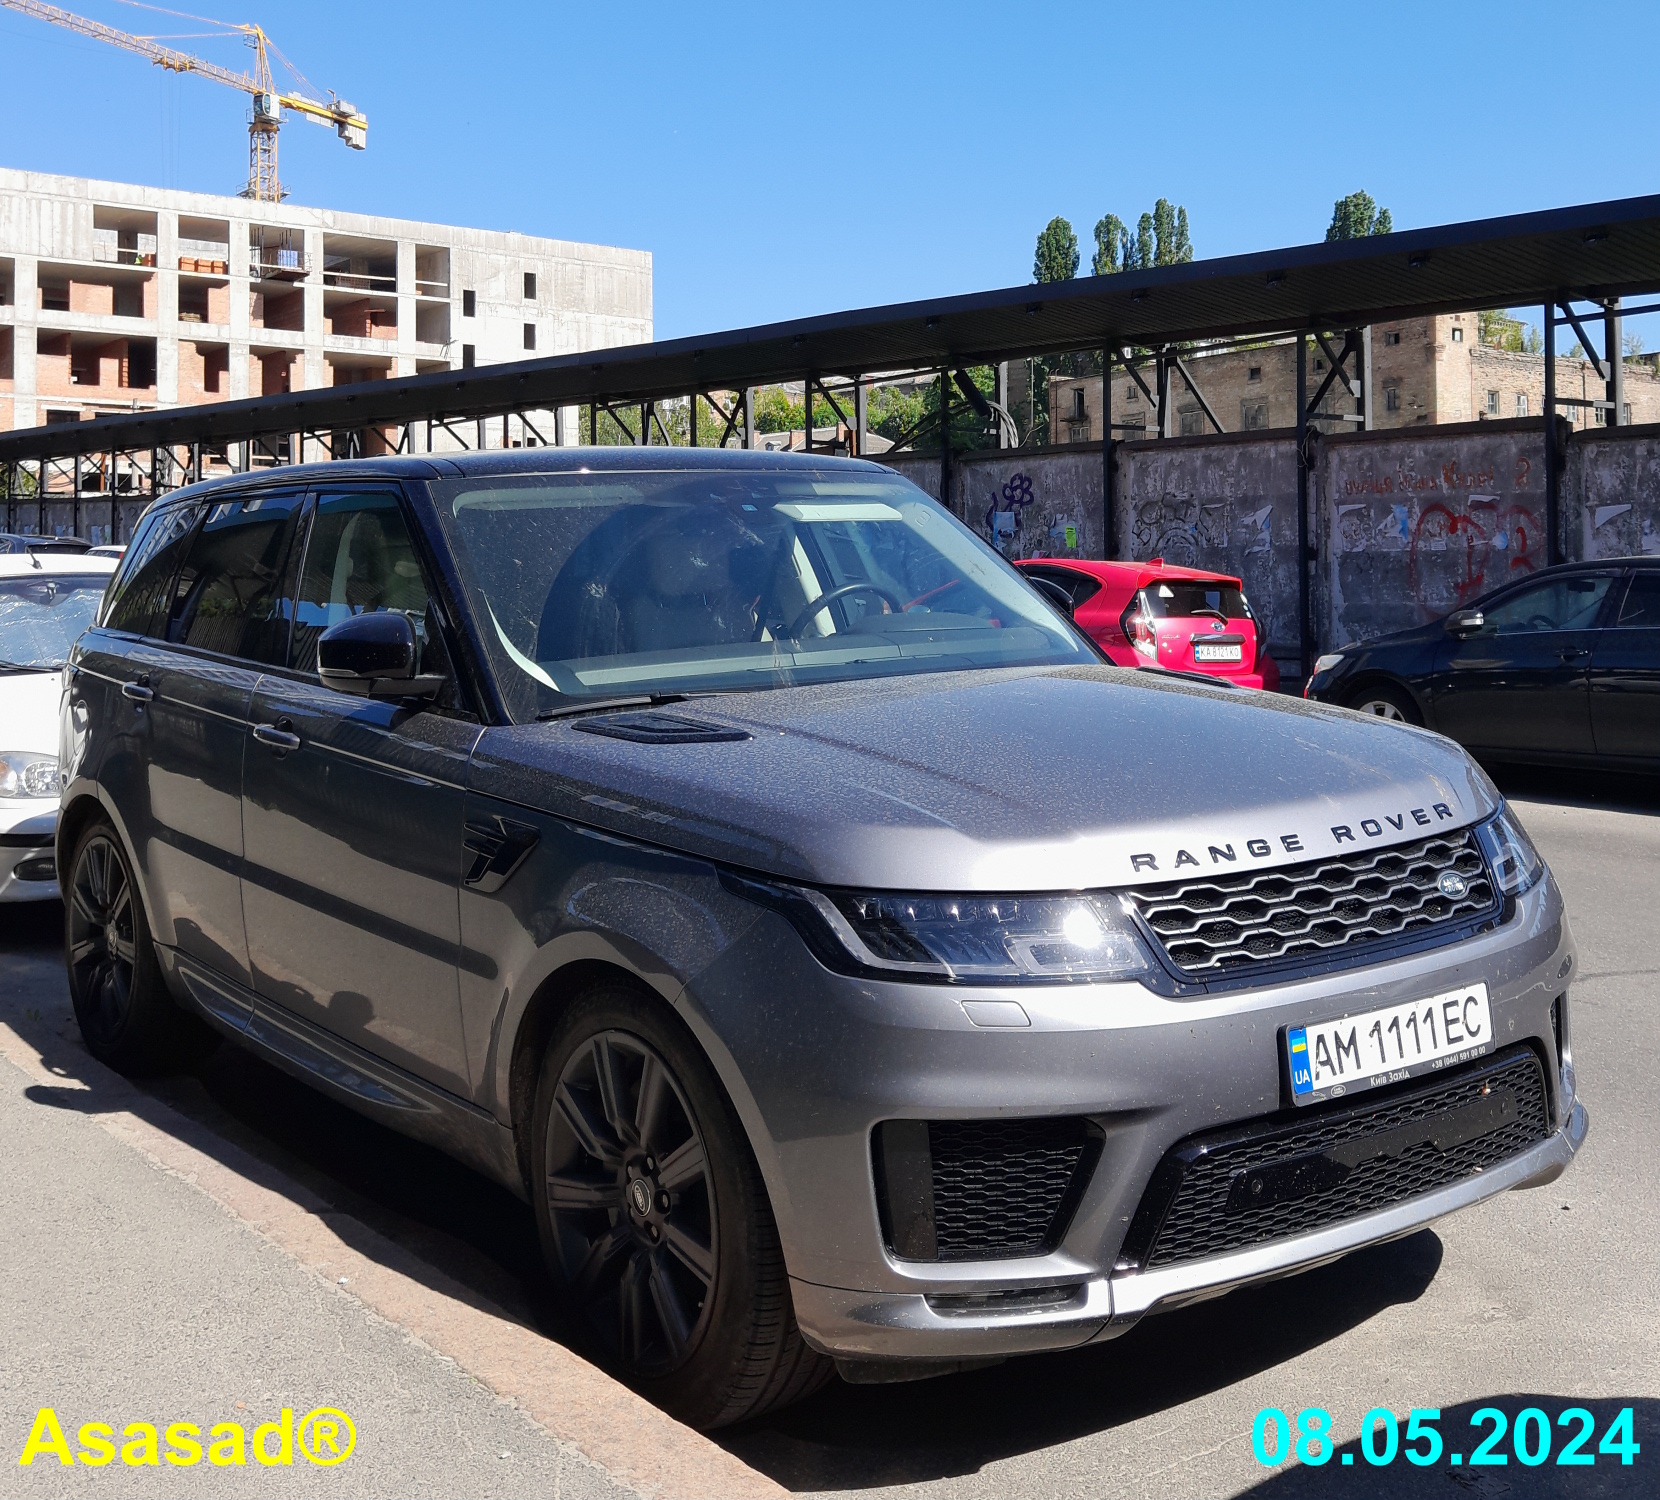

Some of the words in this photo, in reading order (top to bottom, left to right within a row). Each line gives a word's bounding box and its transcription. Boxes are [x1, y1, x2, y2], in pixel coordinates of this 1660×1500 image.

[1130, 834, 1304, 872] RANGE
[1331, 802, 1453, 843] ROVER
[1432, 1060, 1443, 1069] +38
[1295, 1069, 1310, 1085] UA
[1370, 1074, 1387, 1087] Київ
[1389, 1069, 1411, 1082] Захід
